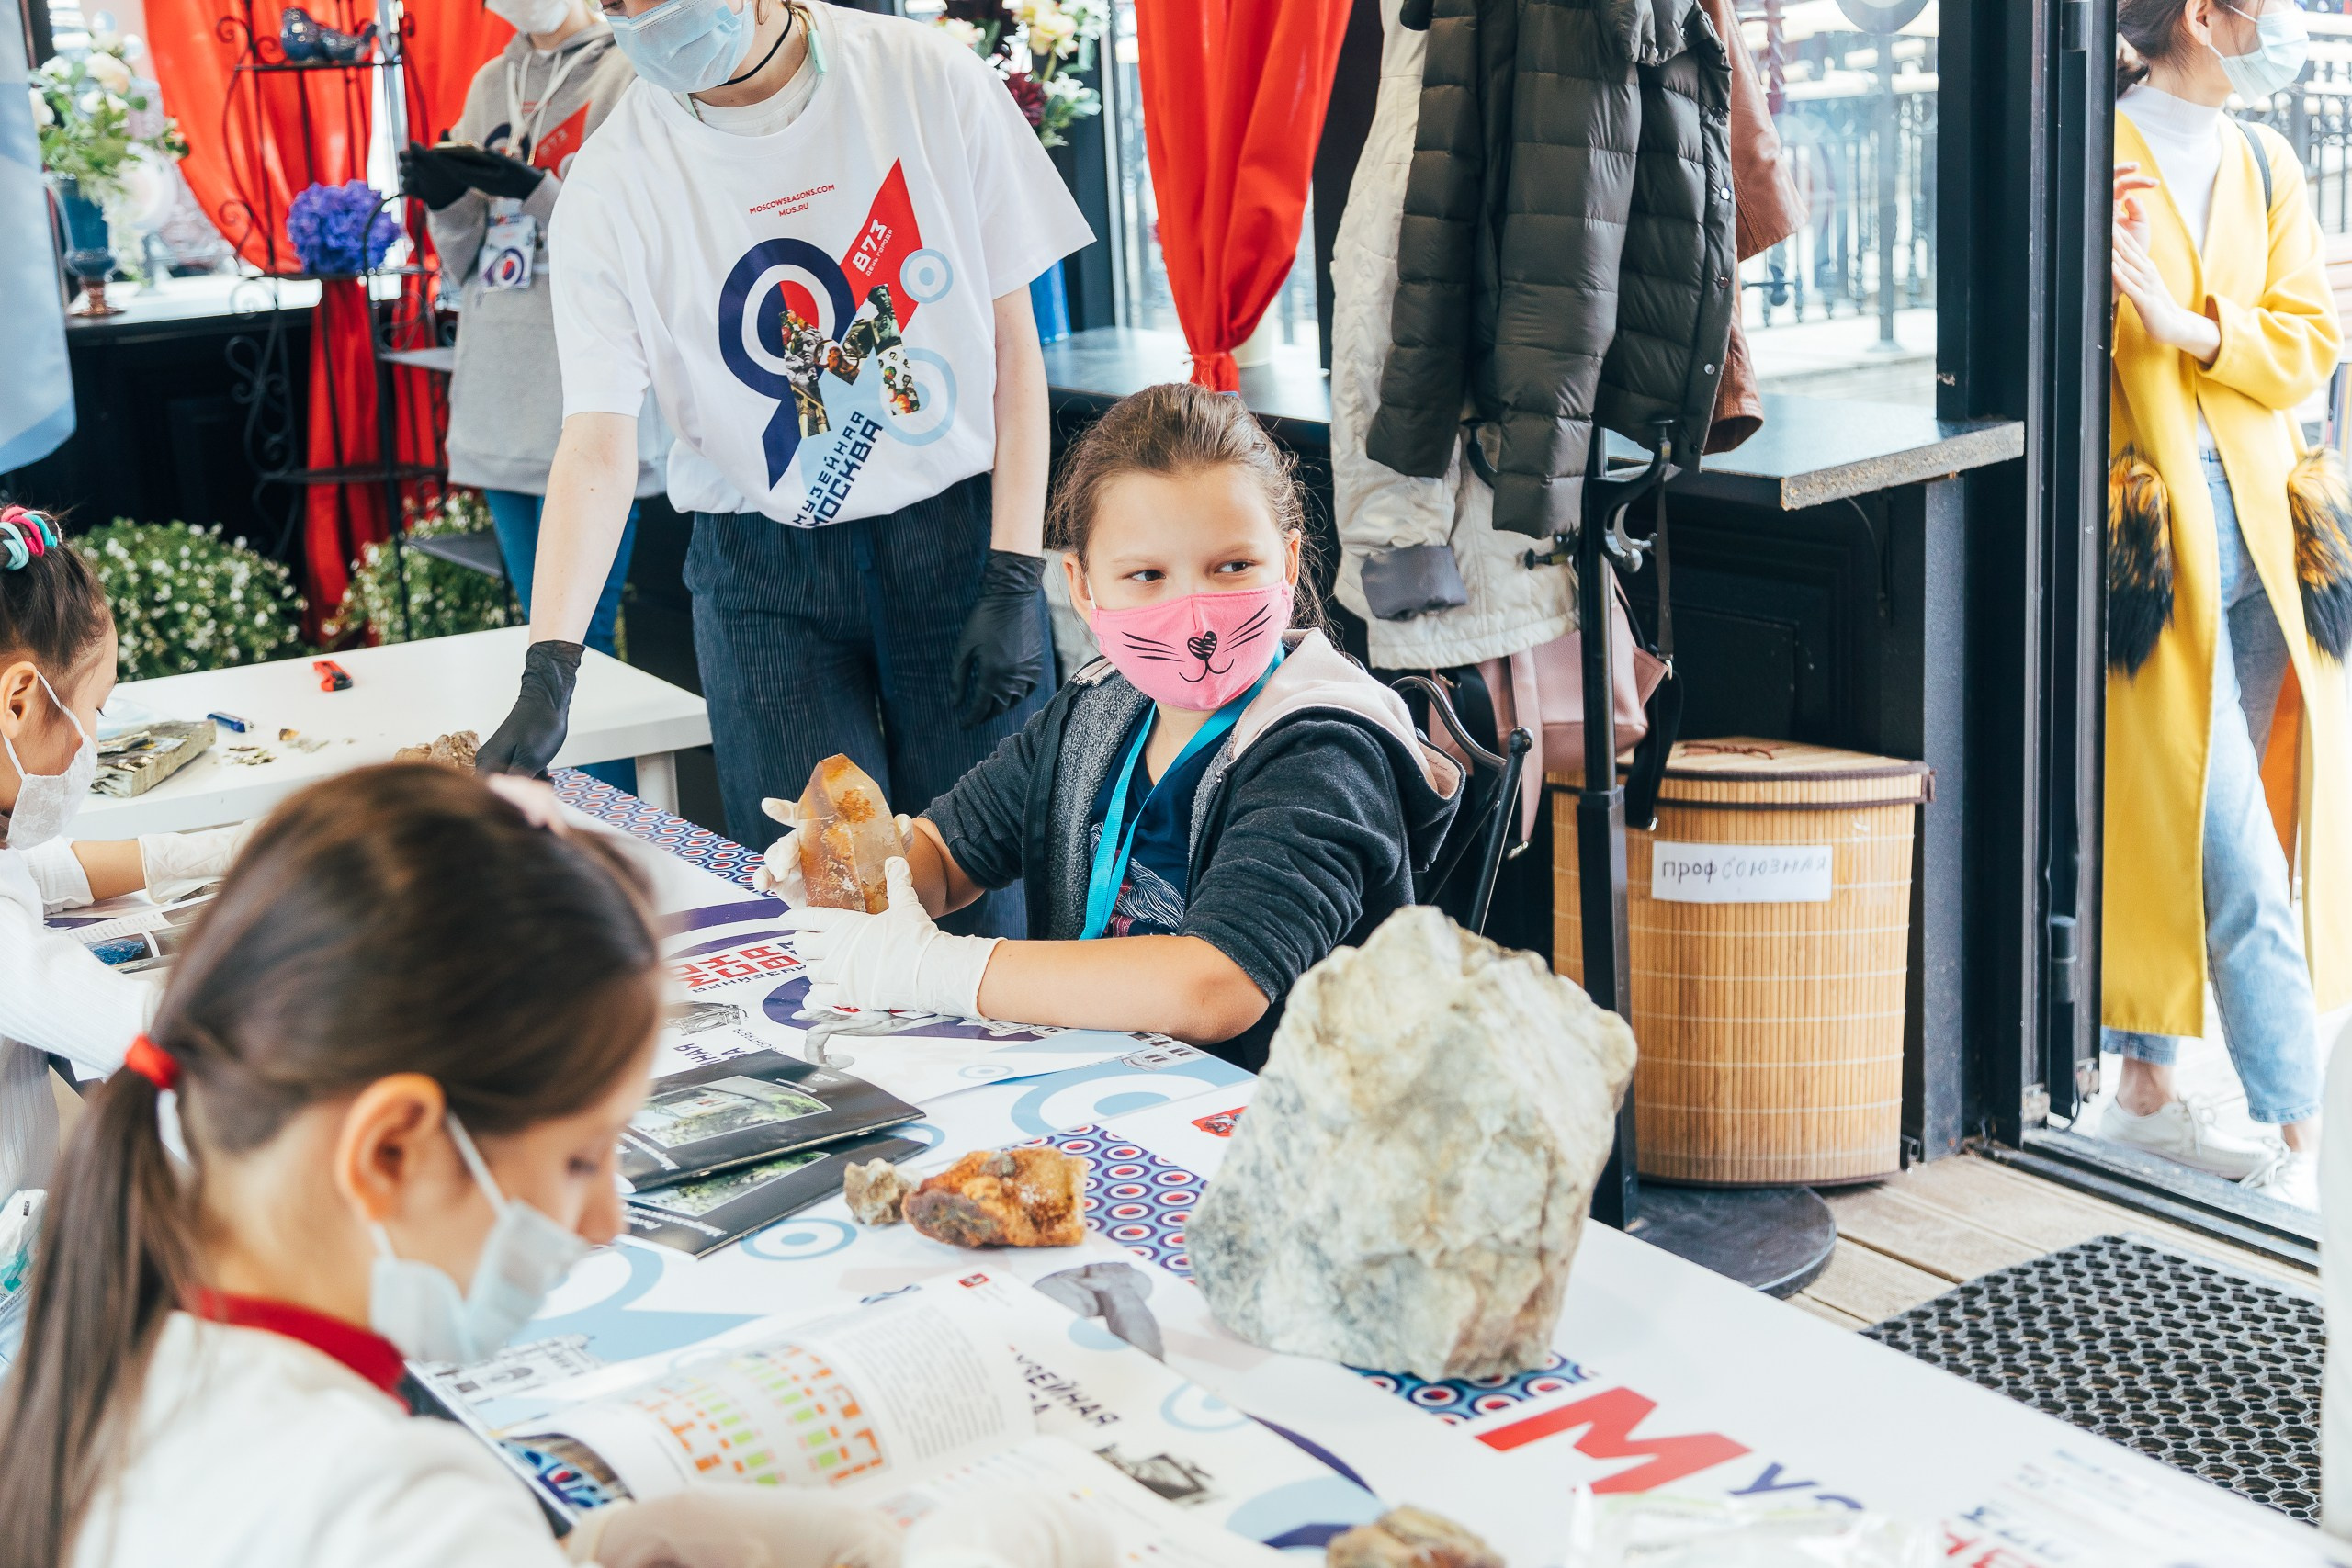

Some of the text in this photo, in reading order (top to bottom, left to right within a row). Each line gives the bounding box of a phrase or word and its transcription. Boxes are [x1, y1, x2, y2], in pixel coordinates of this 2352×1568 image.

[749, 184, 835, 214] MOSCOWSEASONS.COM
[778, 202, 808, 217] MOS.RU
[852, 219, 888, 272] 873
[865, 229, 894, 276] ДЕНЬ ГОРОДА
[792, 411, 865, 525] МУЗЕЙНАЯ
[805, 419, 884, 527] МОСКВА
